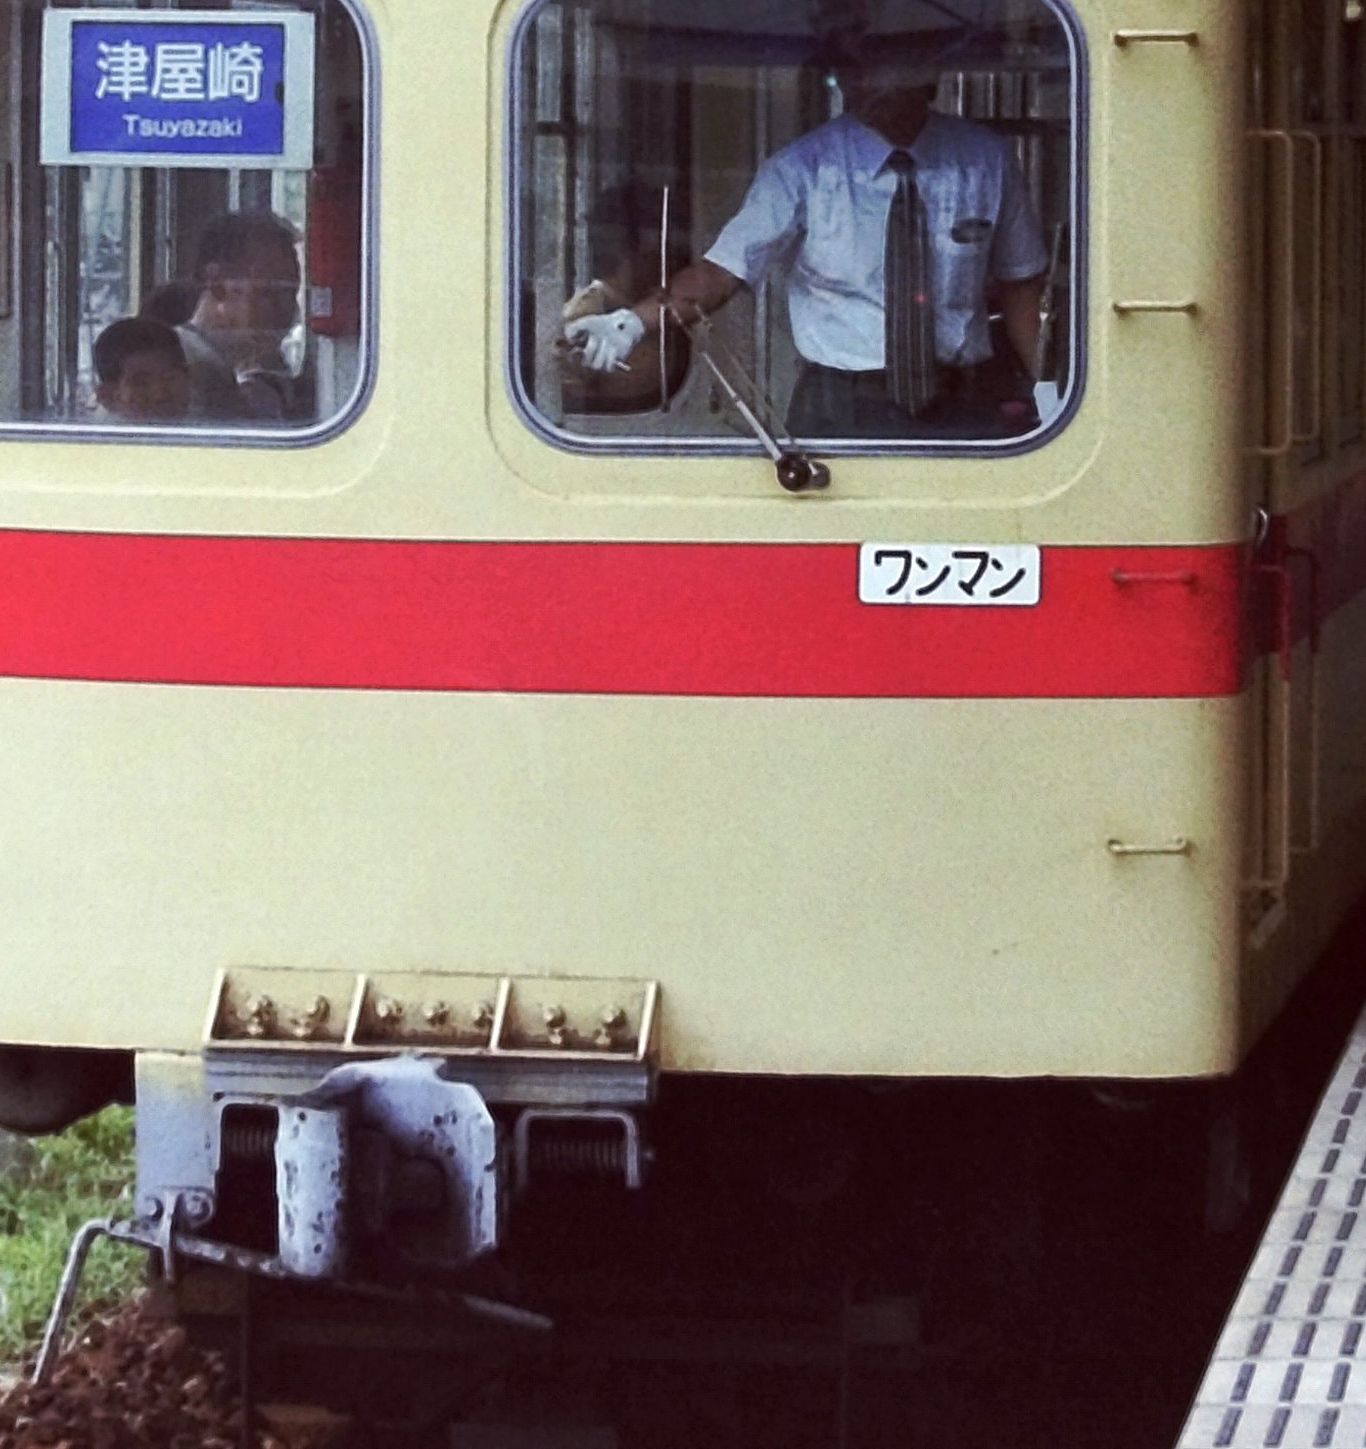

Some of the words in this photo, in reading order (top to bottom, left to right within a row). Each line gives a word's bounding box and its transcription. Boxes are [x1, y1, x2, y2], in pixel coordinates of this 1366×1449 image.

[95, 39, 264, 103] 津屋崎
[122, 113, 243, 138] Tsuyazaki
[874, 549, 1026, 597] ワンマン
